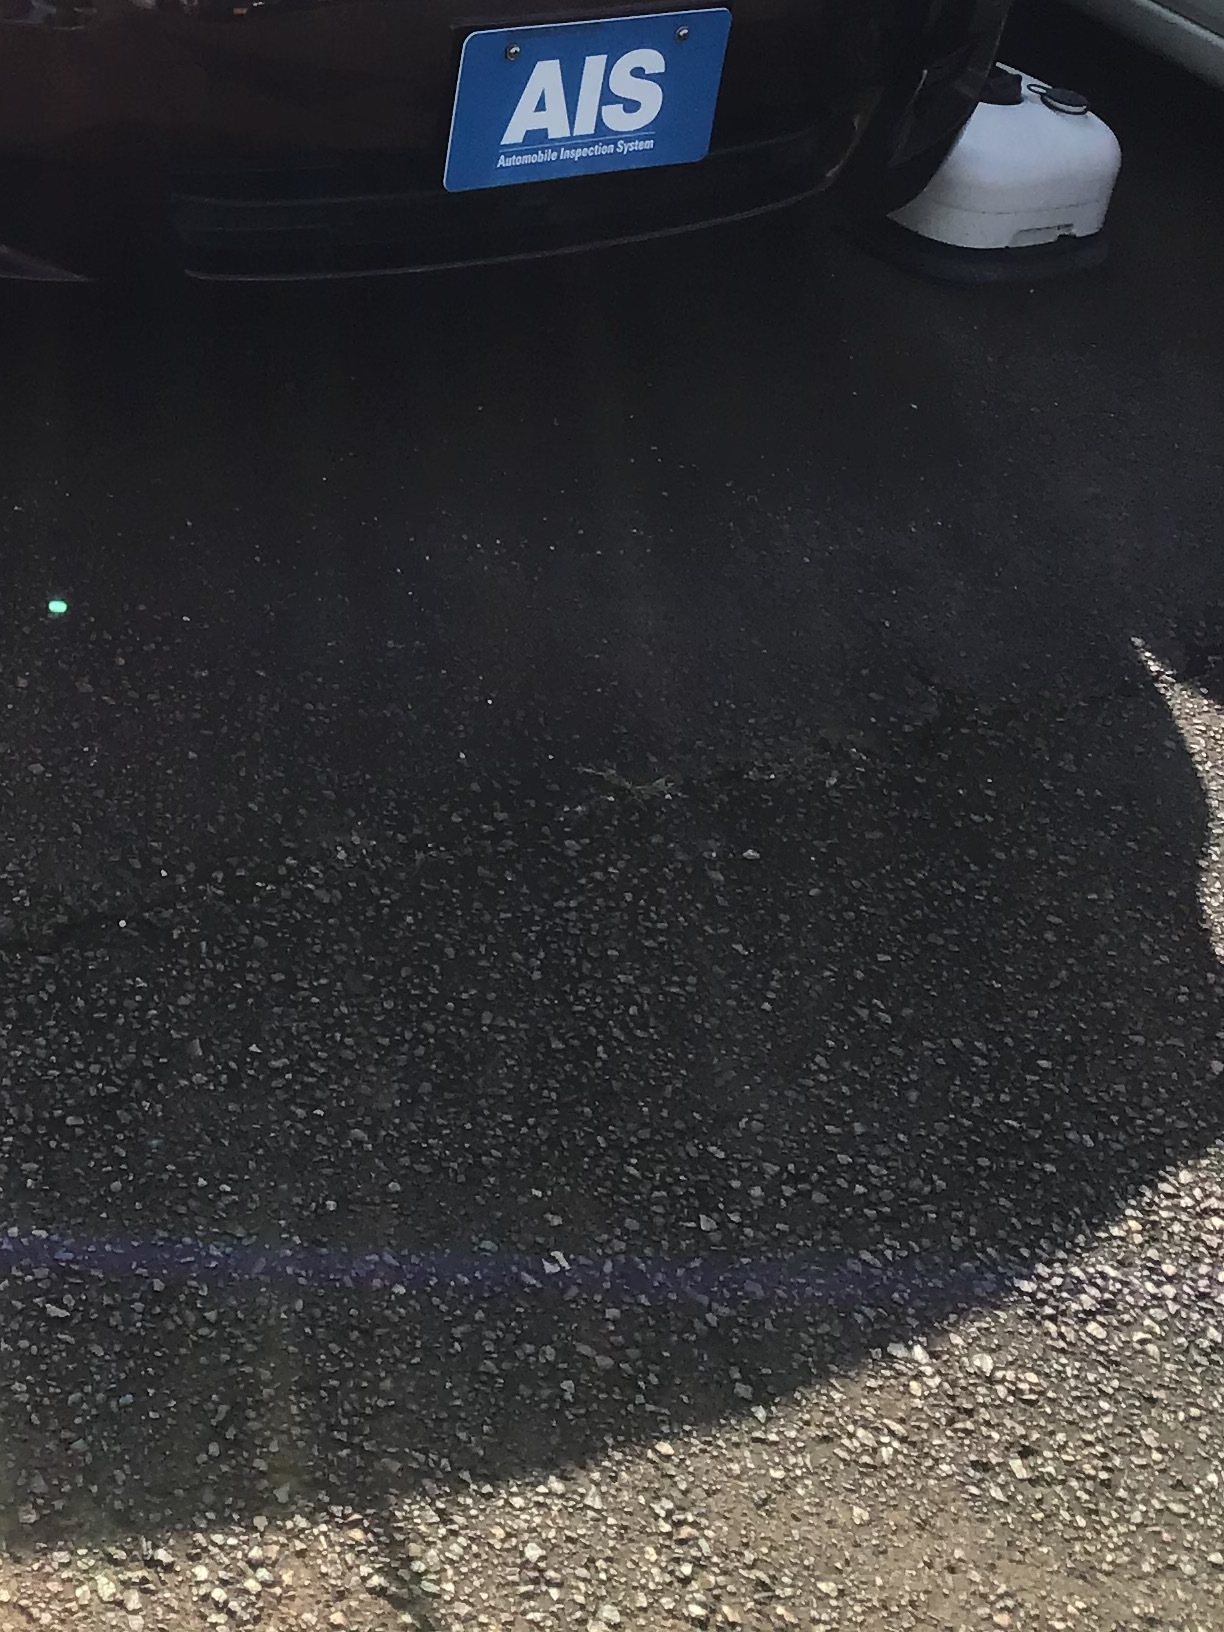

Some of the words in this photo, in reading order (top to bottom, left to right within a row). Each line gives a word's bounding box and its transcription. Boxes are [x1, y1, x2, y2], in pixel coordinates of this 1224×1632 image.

[500, 48, 666, 145] AIS
[496, 150, 558, 168] Automobile
[559, 144, 615, 162] Inspection
[615, 137, 655, 156] System
